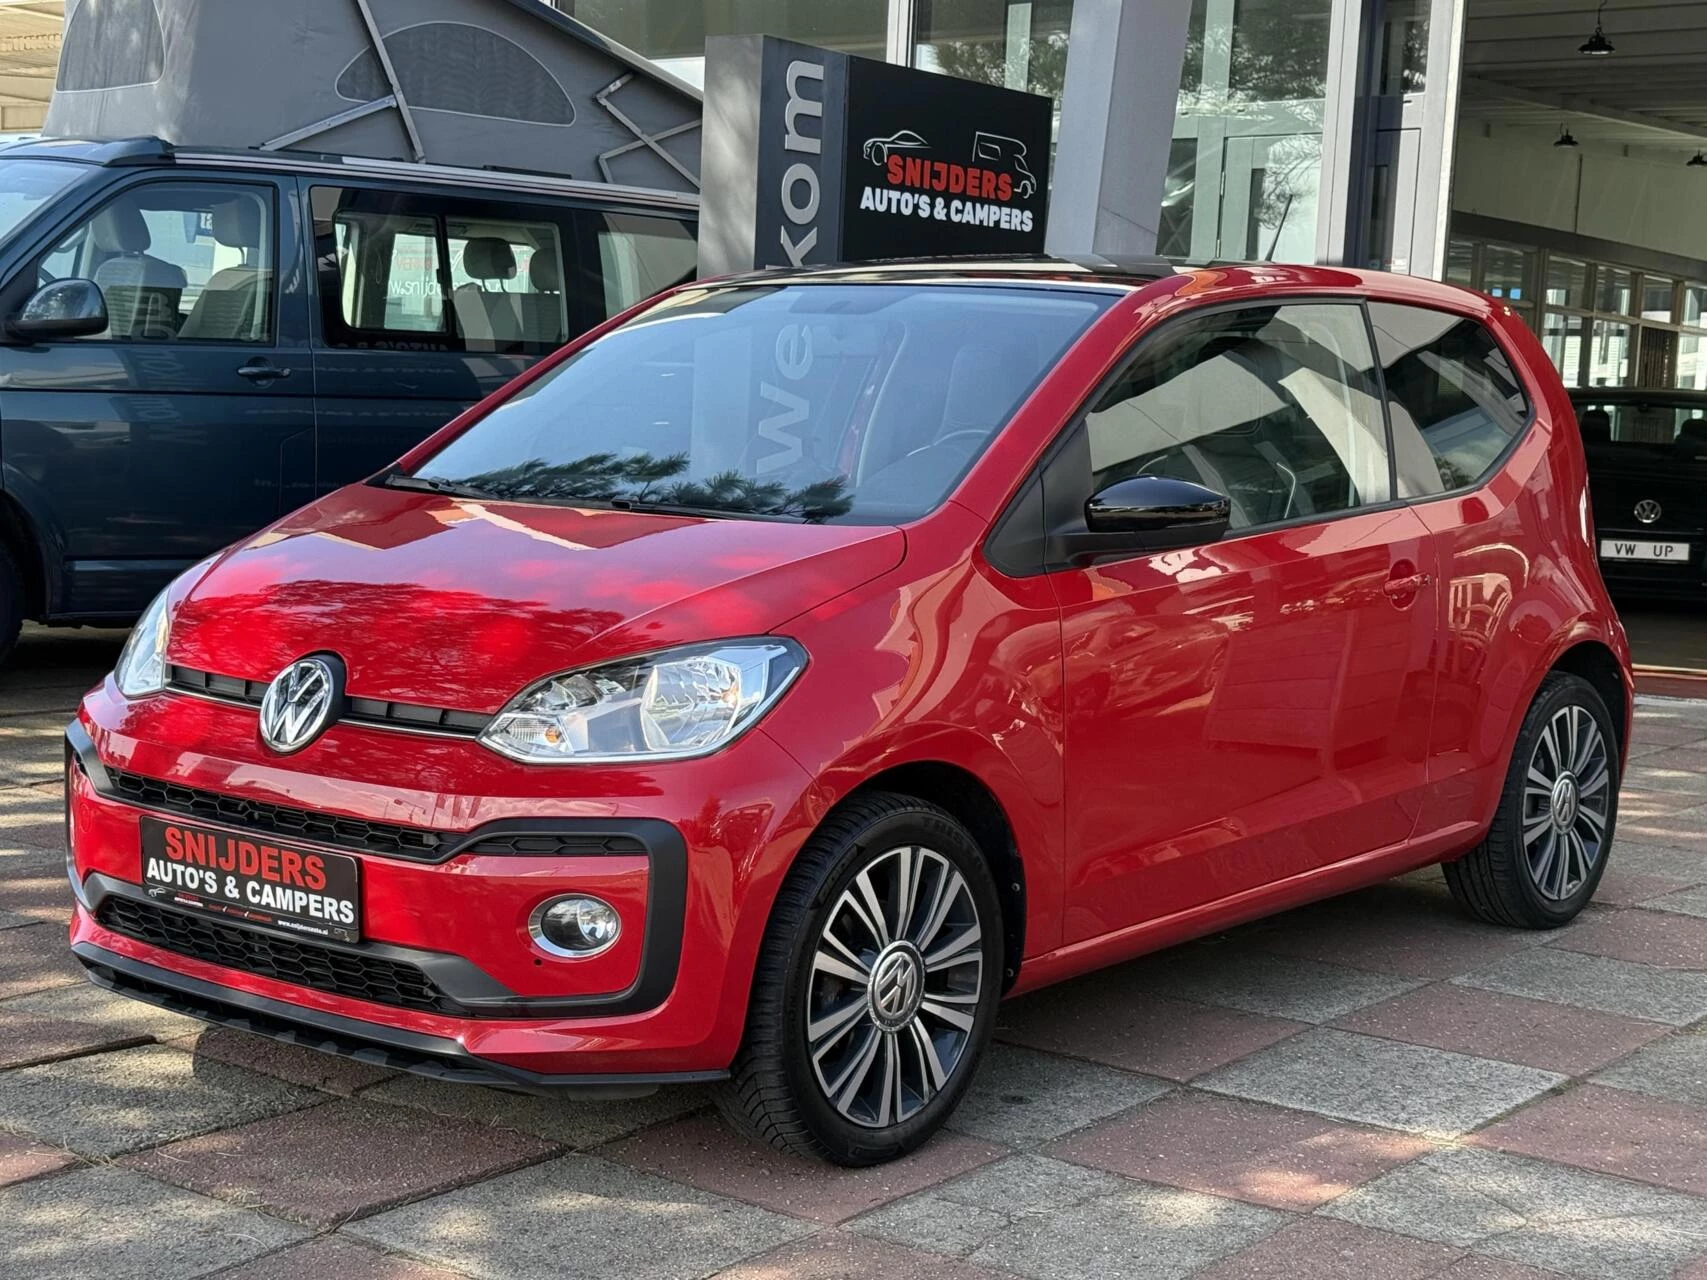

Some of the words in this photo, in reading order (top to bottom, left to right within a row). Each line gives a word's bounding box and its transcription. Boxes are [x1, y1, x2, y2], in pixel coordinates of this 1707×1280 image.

[887, 154, 1013, 201] SNIJDERS
[860, 186, 931, 218] AUTO'S
[933, 200, 947, 220] &
[950, 200, 1033, 232] CAMPERS
[1614, 543, 1637, 556] VW
[1653, 545, 1674, 557] UP
[164, 826, 327, 892] SNIJDERS
[146, 857, 218, 894] AUTO'S
[224, 875, 240, 900] &
[246, 881, 355, 924] CAMPERS
